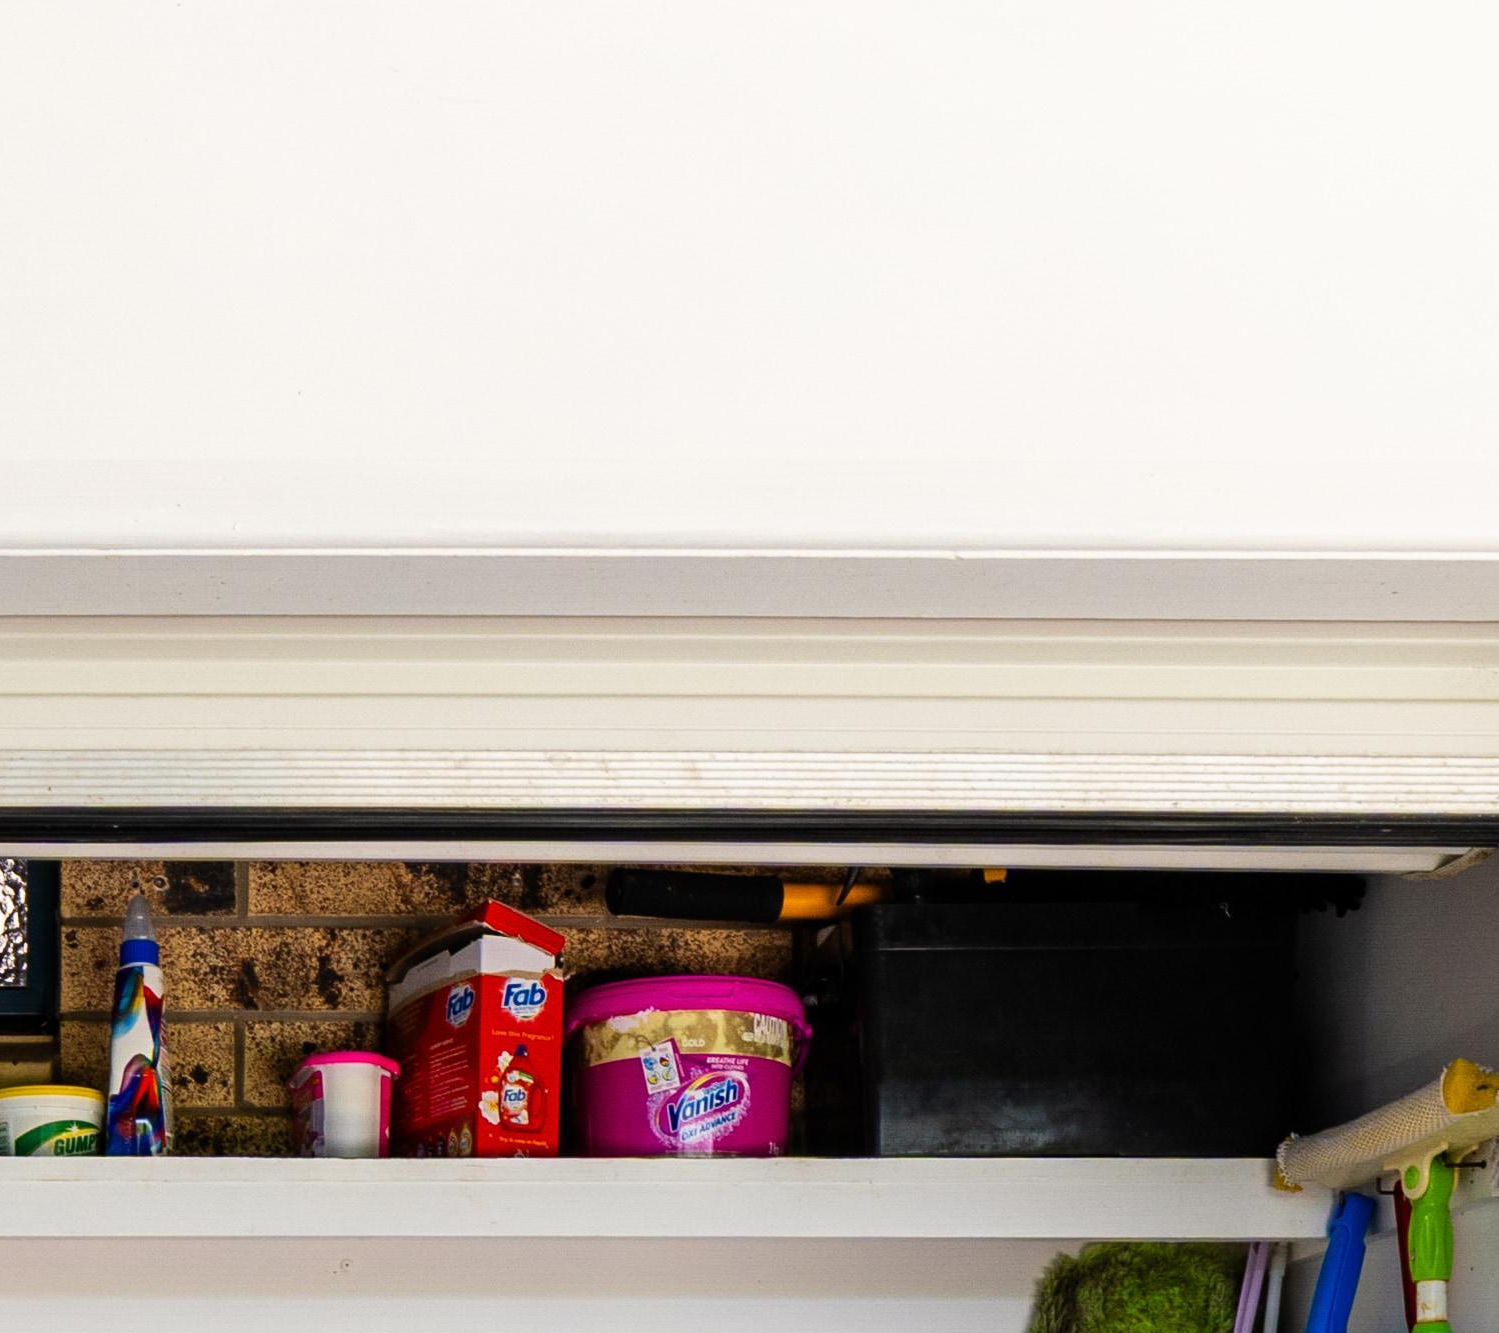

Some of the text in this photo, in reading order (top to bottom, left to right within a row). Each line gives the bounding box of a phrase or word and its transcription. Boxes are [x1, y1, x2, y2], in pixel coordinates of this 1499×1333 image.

[447, 987, 474, 1020] Fab
[503, 983, 546, 1007] Fab
[503, 1089, 526, 1102] Fab
[667, 1079, 739, 1133] Vanish
[681, 1111, 737, 1142] OXI ADVANCE
[54, 1135, 97, 1155] GUMP
